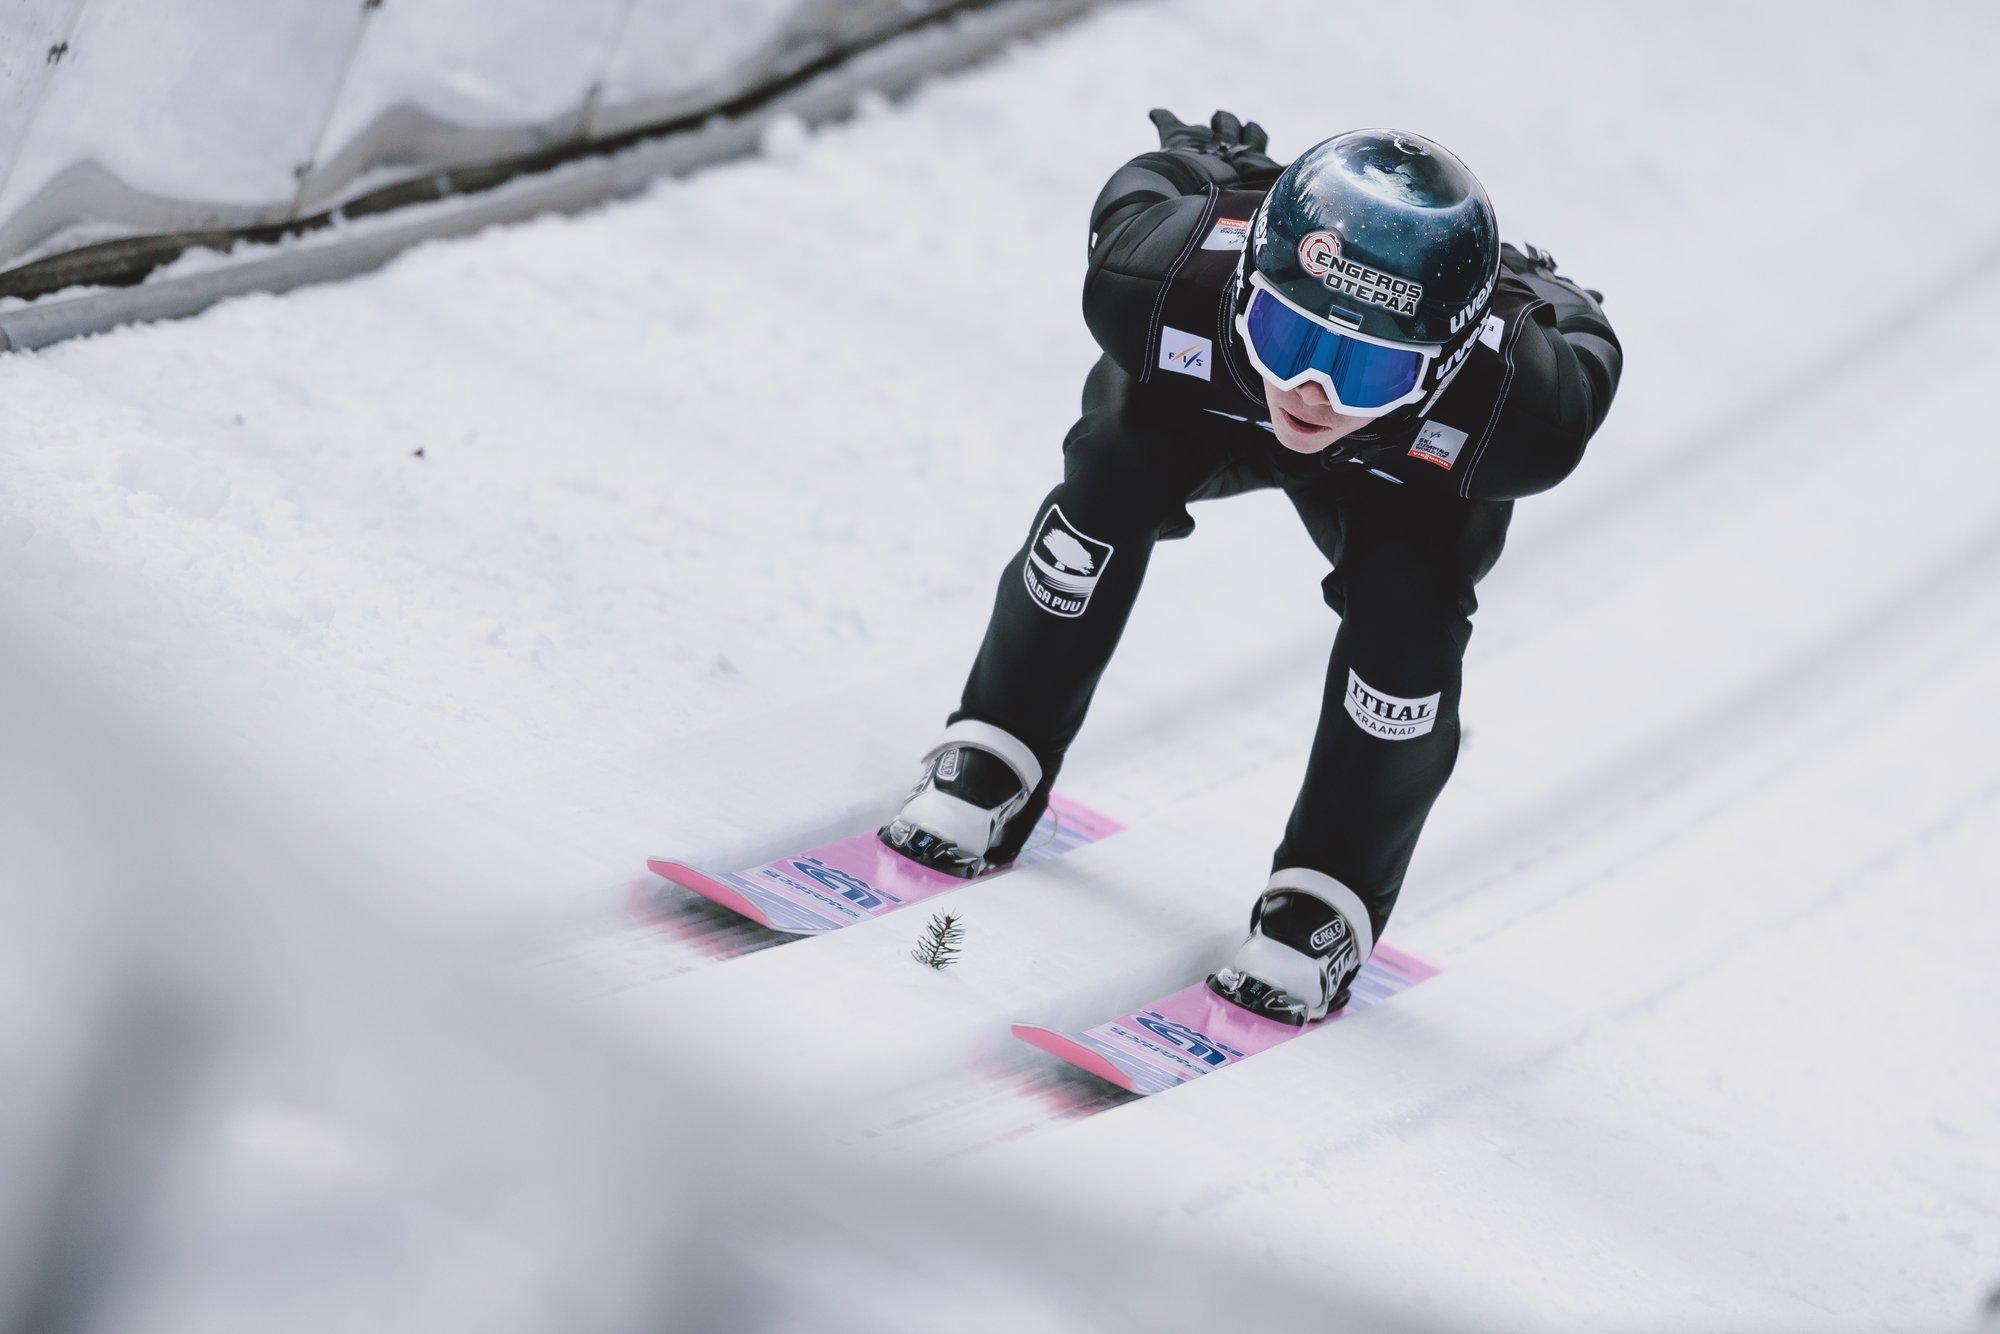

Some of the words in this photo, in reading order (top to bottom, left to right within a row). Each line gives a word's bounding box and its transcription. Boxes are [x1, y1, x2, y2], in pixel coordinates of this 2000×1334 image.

[1315, 250, 1422, 299] ENGEROS
[1325, 273, 1418, 316] OTEPÄÄ
[1450, 274, 1493, 334] uvex
[1417, 442, 1450, 456] JUMPING
[1051, 596, 1082, 612] PUU
[1355, 709, 1416, 736] KRAANAD
[1313, 923, 1342, 945] EAGLE
